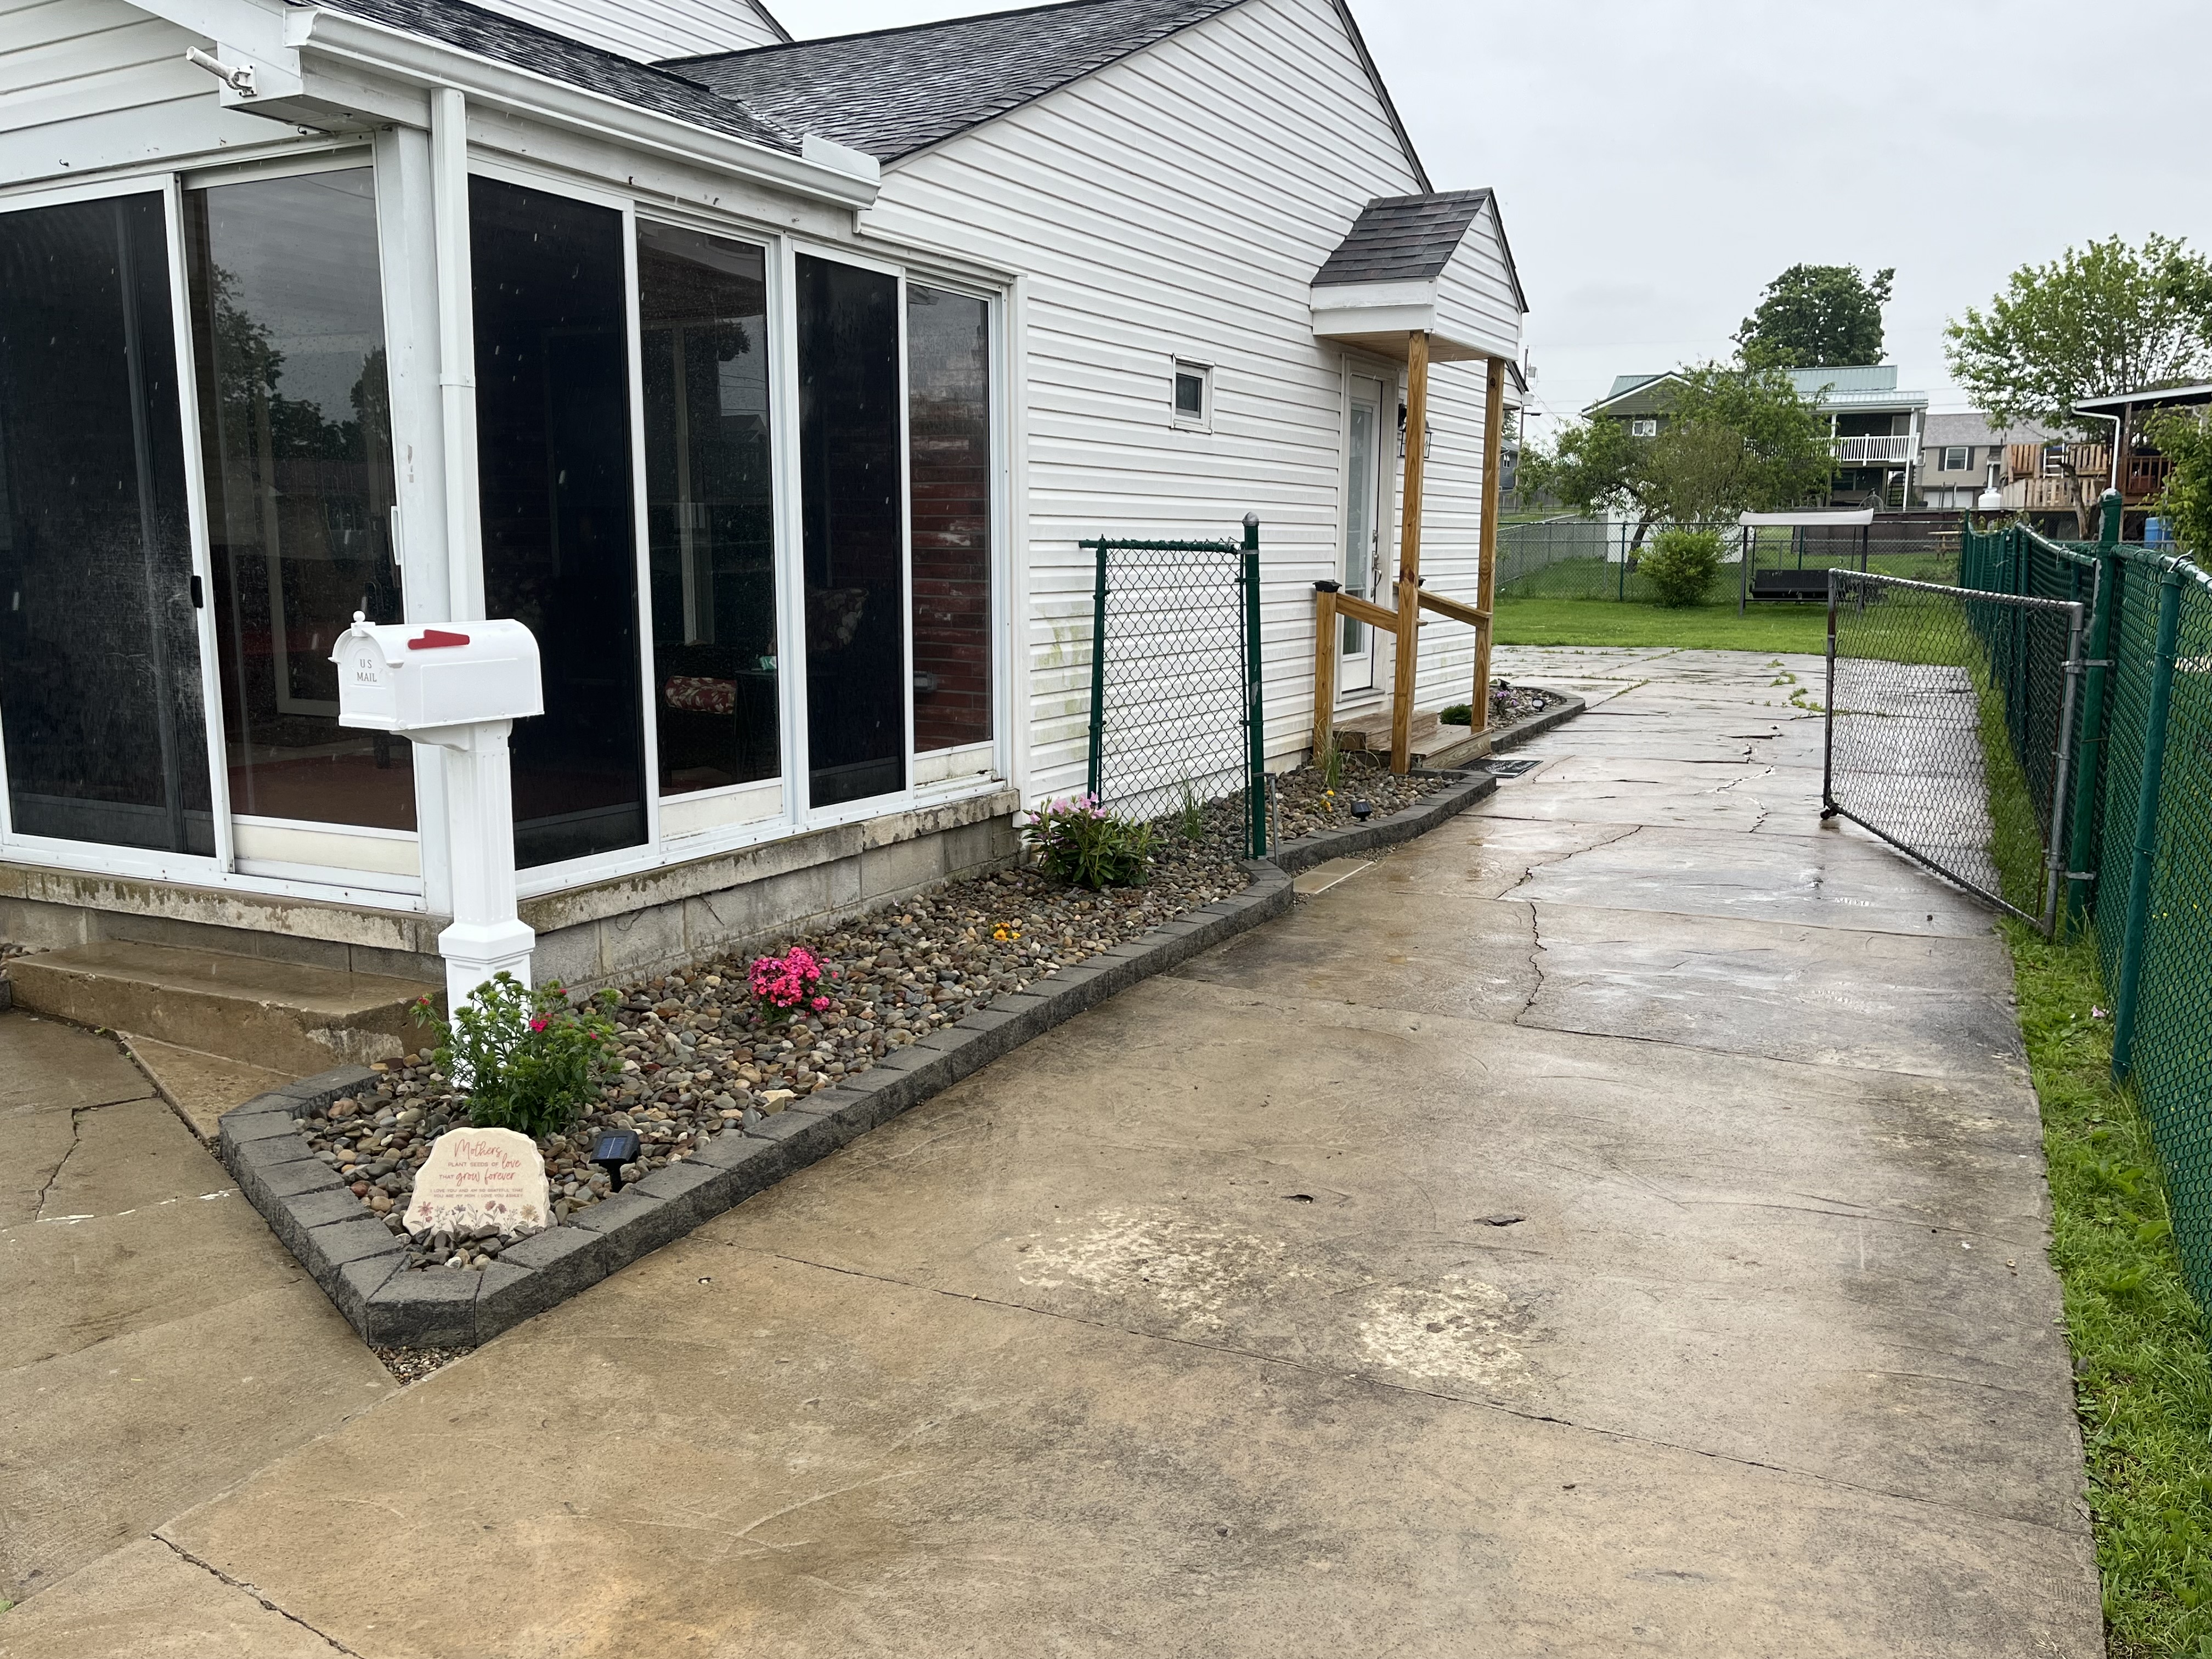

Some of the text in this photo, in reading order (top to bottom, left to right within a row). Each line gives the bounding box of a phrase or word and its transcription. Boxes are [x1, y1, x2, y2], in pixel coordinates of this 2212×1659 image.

[357, 672, 377, 682] MAIL
[454, 1139, 503, 1160] Mothers
[502, 1153, 521, 1169] love
[456, 1172, 480, 1187] grow
[485, 1168, 515, 1185] forever
